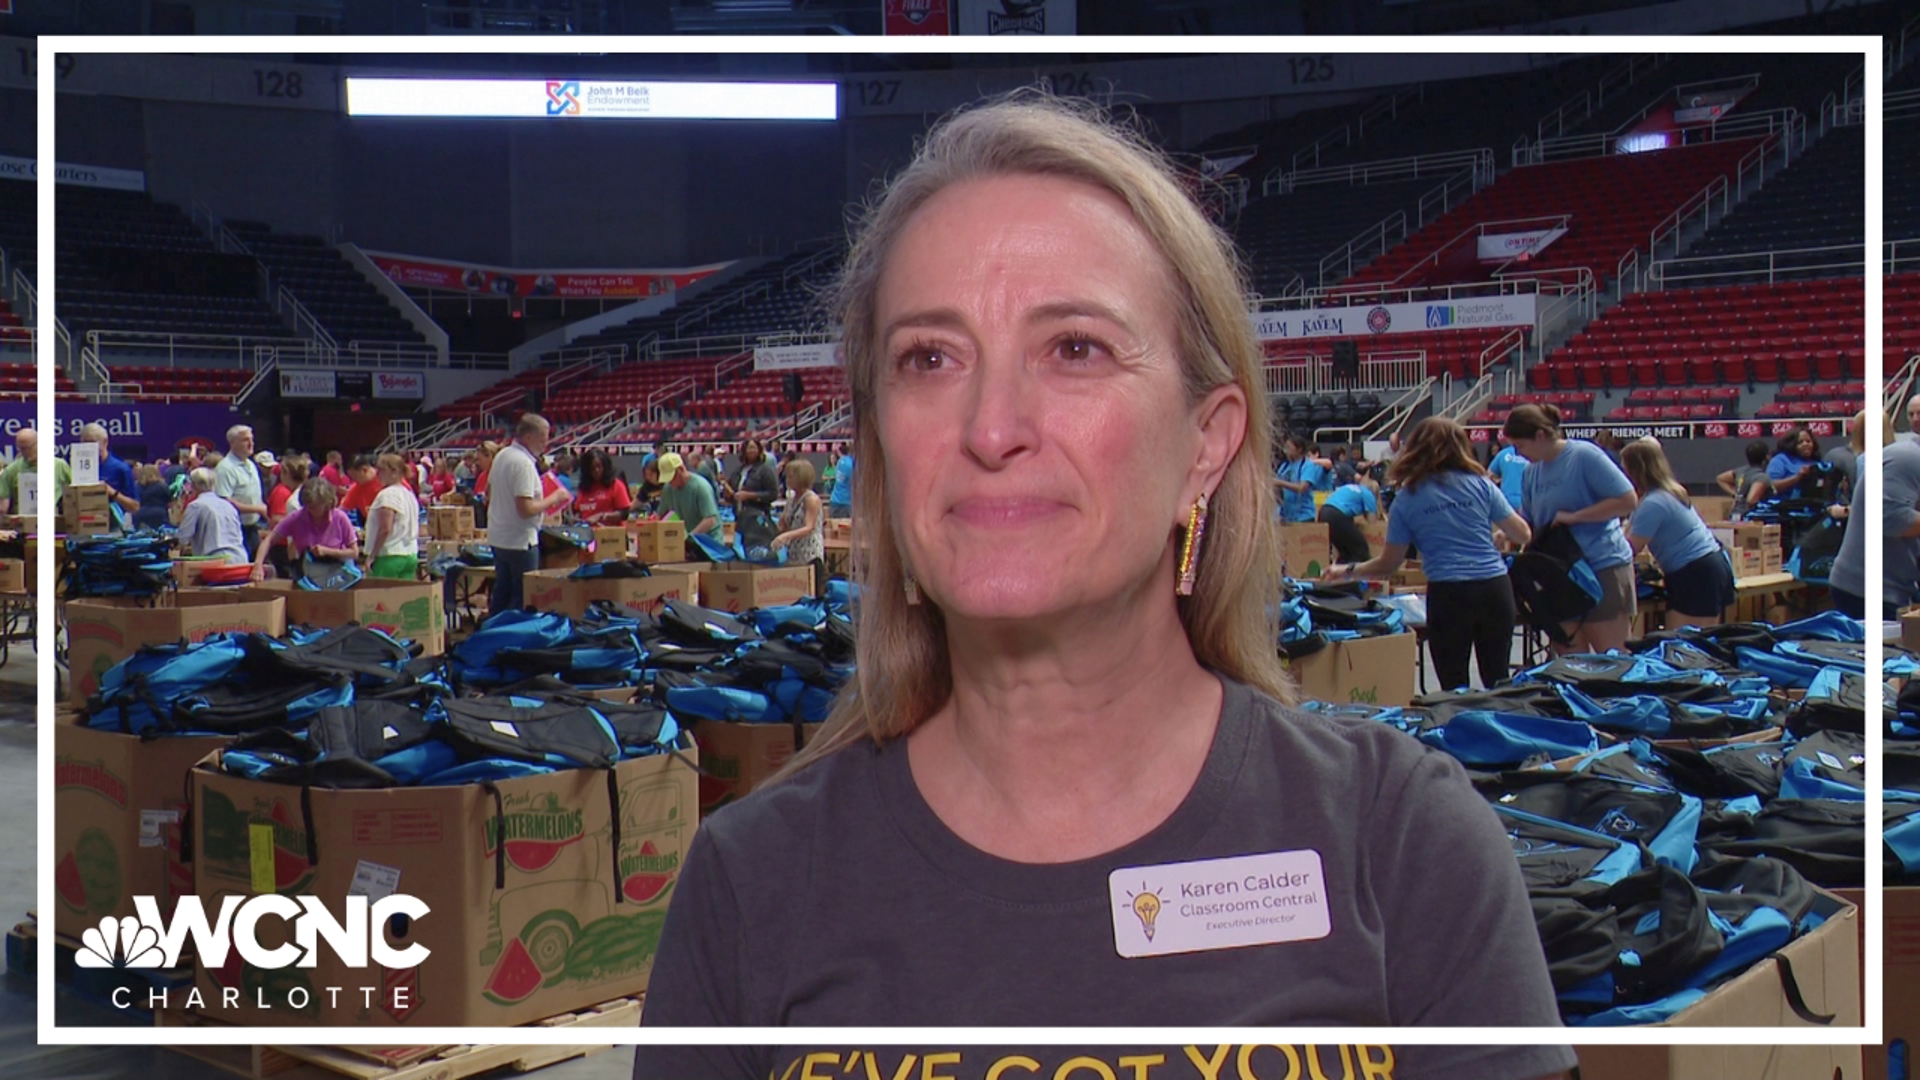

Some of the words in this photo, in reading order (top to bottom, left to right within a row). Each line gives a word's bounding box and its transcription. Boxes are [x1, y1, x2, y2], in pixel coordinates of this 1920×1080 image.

[989, 9, 1044, 34] CHECKERS
[1286, 53, 1336, 84] 125
[253, 69, 303, 98] 128
[587, 86, 613, 96] John
[616, 86, 625, 96] M
[627, 86, 651, 96] Belk
[587, 95, 651, 105] Endowment
[857, 79, 902, 107] 127
[567, 277, 598, 287] People
[600, 277, 616, 286] Can
[618, 277, 634, 286] Tell
[559, 287, 585, 295] When
[586, 287, 601, 295] You
[1457, 303, 1504, 314] Piedmont
[1303, 318, 1343, 336] KAYEM
[1457, 313, 1492, 325] Natural
[1256, 321, 1288, 337] AYEM
[378, 374, 418, 389] Bojangles
[1608, 427, 1652, 439] RIENDS
[1654, 427, 1684, 437] MEET
[79, 459, 91, 470] 18
[1350, 685, 1377, 703] Fresh
[504, 791, 530, 808] Fresh
[620, 850, 678, 879] WATERMELONS
[1180, 881, 1239, 899] Karen
[1243, 871, 1311, 892] Calder
[1180, 899, 1260, 918] Classroom
[1262, 891, 1318, 910] Central
[1206, 918, 1254, 931] Executive
[1254, 913, 1297, 926] Director
